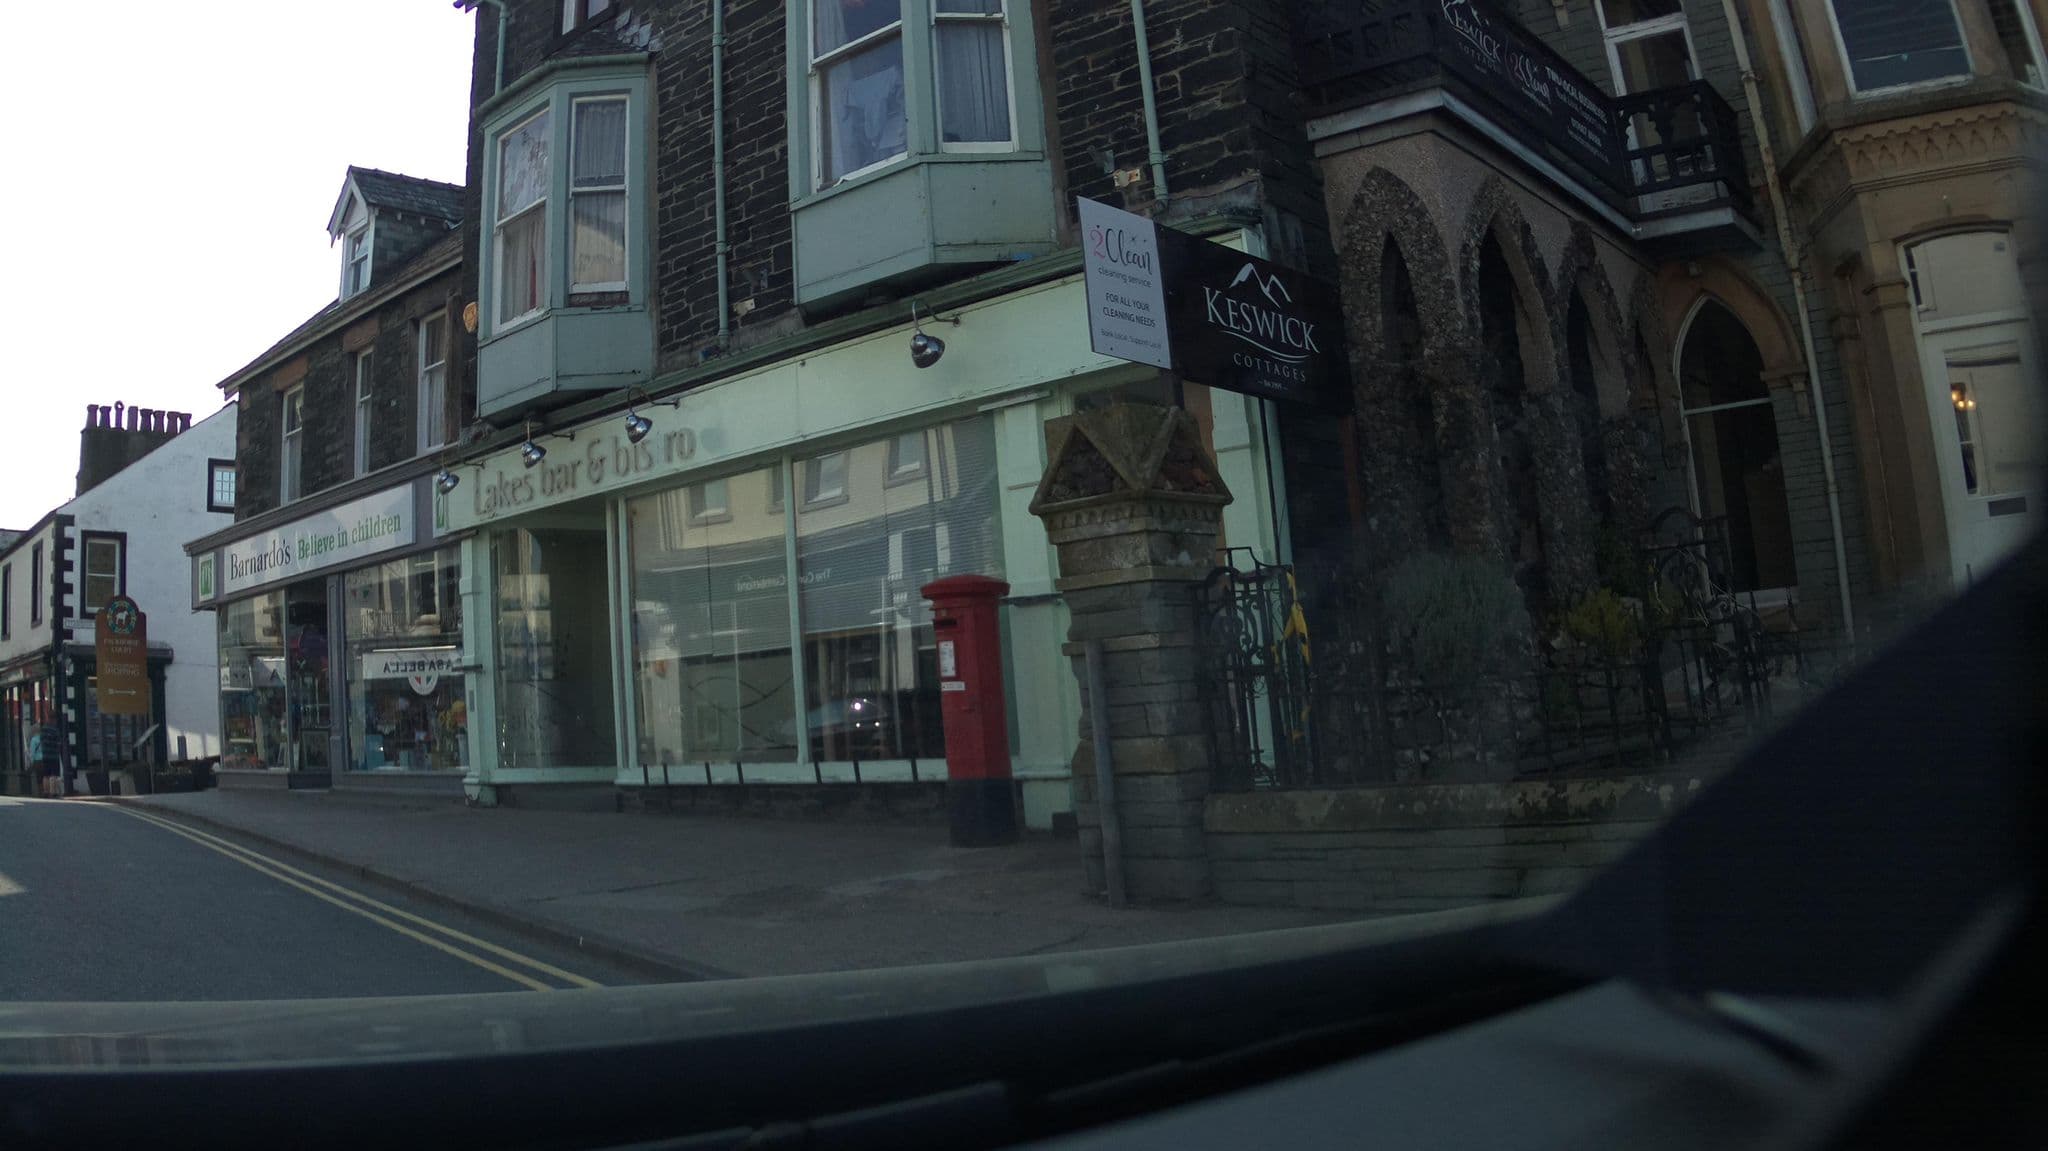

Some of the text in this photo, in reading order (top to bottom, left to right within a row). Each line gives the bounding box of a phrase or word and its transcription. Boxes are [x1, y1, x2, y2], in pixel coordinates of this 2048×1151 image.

[1090, 226, 1153, 275] 2Clean
[1097, 266, 1128, 284] cleaning
[1103, 306, 1156, 328] CLEANING NEEDS
[1105, 292, 1151, 312] FOR ALL YOUR
[1203, 286, 1320, 354] KESWICK
[1233, 352, 1306, 382] COTTAGES
[472, 467, 534, 515] Lakes
[540, 459, 583, 497] bar
[587, 438, 607, 485] &
[230, 513, 402, 581] Barnardo's Believe in children
